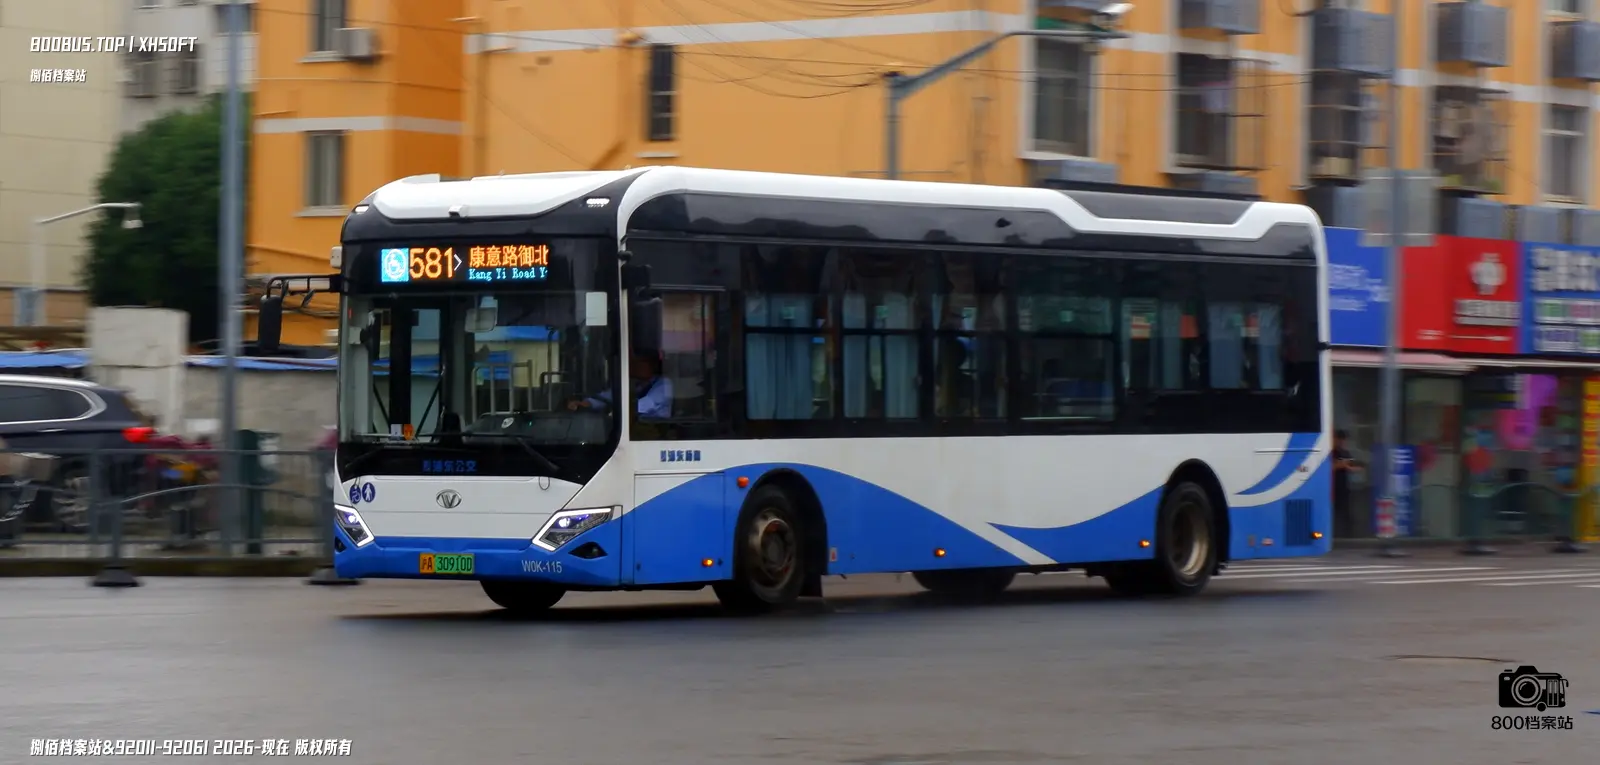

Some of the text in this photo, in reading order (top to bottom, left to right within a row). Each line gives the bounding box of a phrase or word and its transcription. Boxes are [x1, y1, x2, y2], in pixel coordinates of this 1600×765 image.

[409, 247, 454, 279] 581
[469, 244, 549, 268] 康意路御北
[468, 266, 549, 281] Kang Yi Road Y
